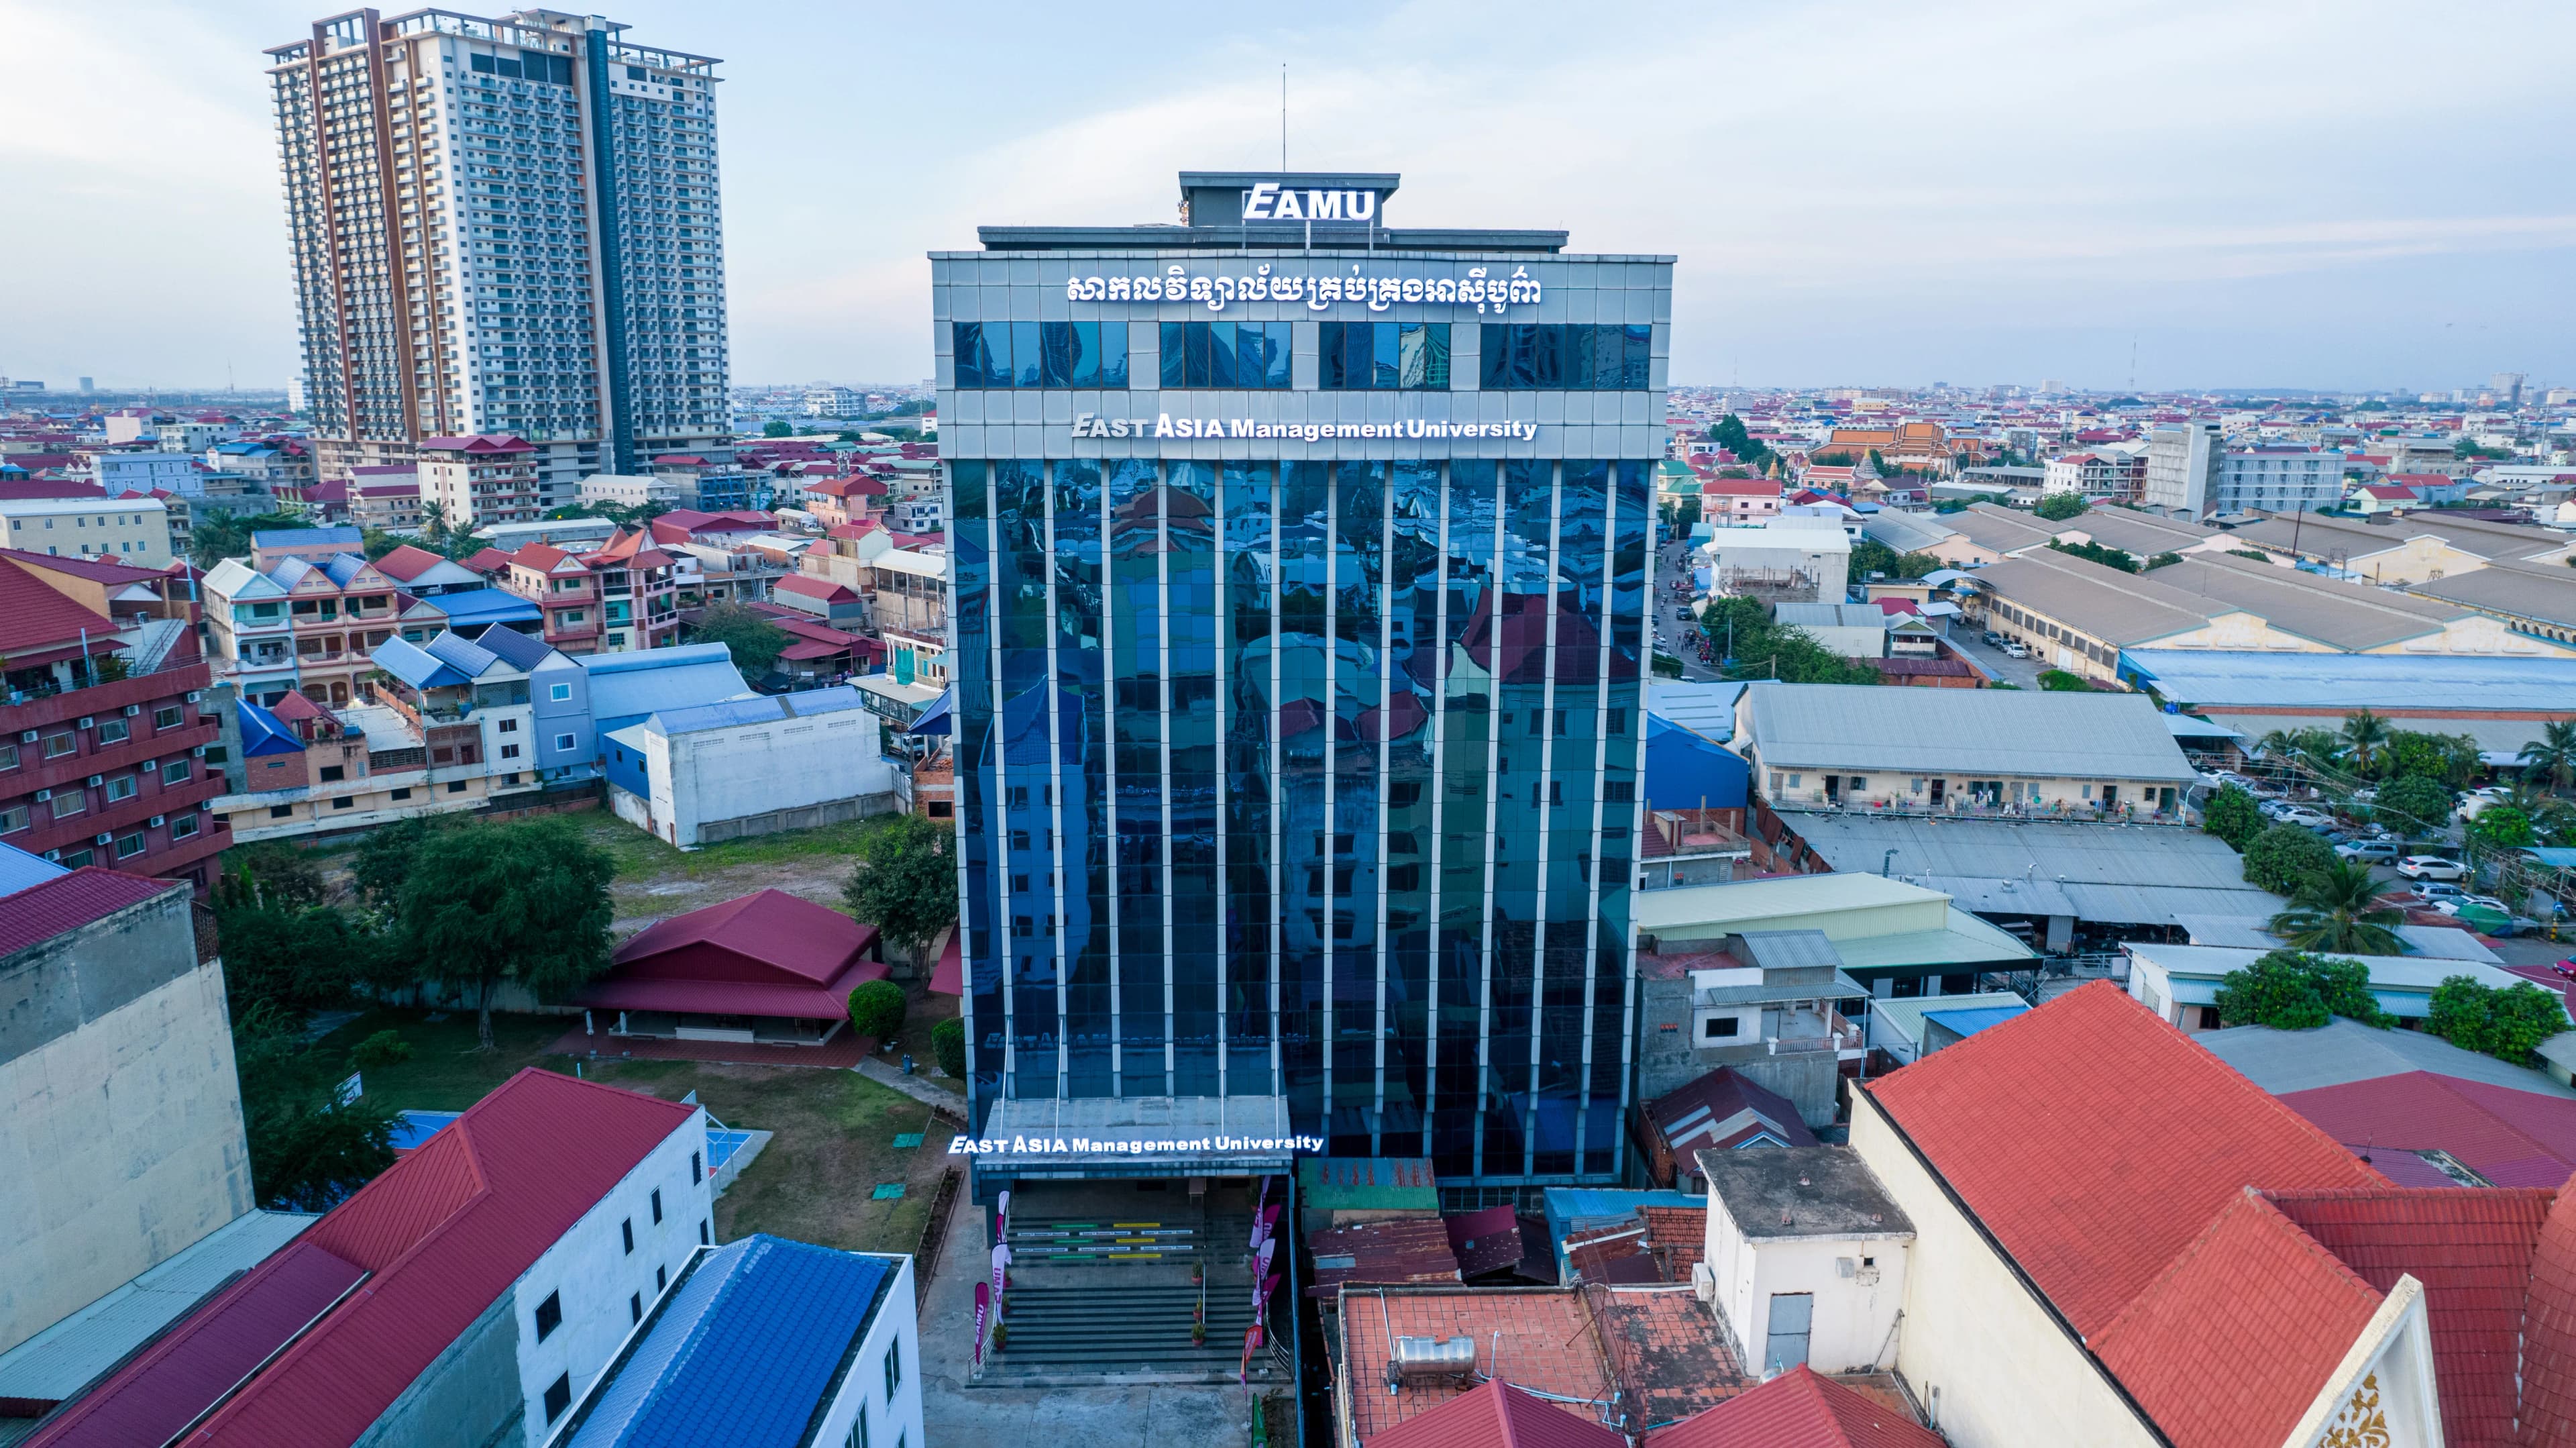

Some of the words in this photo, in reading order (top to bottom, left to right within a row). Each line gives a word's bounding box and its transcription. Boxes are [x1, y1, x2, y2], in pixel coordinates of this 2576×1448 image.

[1242, 183, 1375, 221] EAMU
[1071, 412, 1148, 437] EAST
[1155, 413, 1226, 437] ASIA
[1231, 418, 1403, 442] Management
[1407, 419, 1538, 441] University
[948, 1135, 1009, 1153] EAST
[1012, 1135, 1068, 1153] ASIA
[1073, 1137, 1210, 1153] Management
[1215, 1135, 1324, 1151] University
